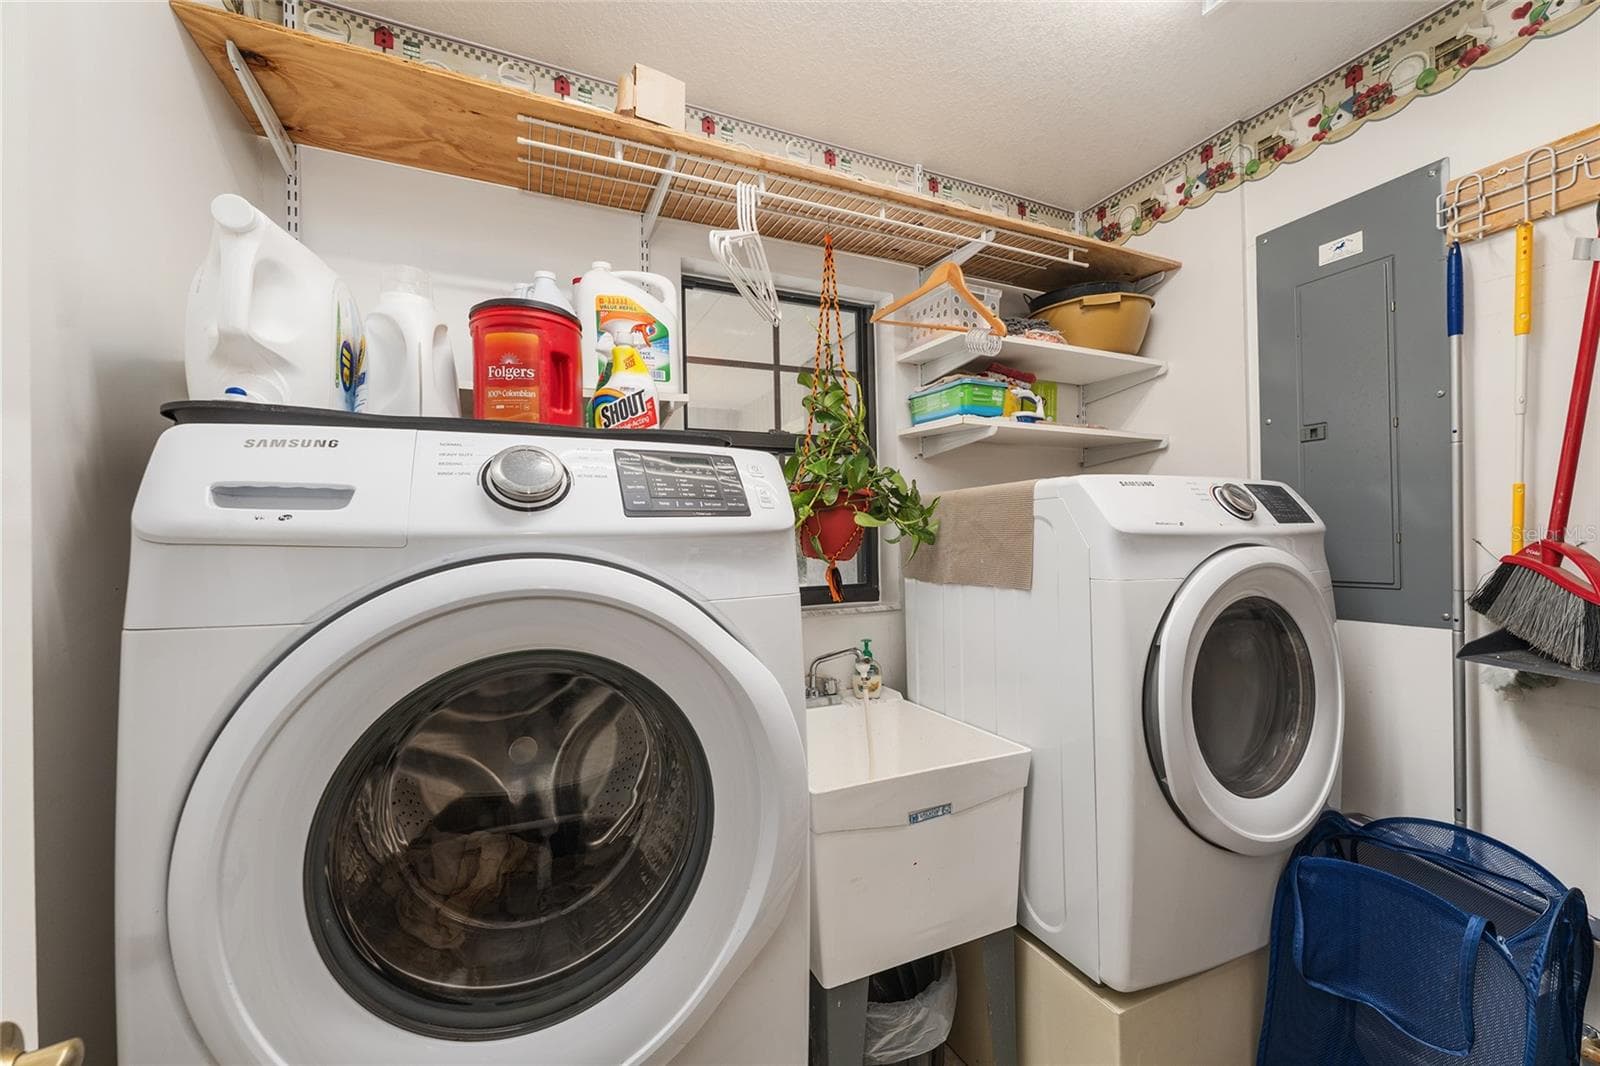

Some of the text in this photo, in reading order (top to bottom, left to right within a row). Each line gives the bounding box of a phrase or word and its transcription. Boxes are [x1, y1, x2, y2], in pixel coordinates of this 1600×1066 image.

[487, 365, 536, 380] Folgers
[601, 389, 646, 428] SHOUT
[243, 438, 340, 449] SAMSUNG
